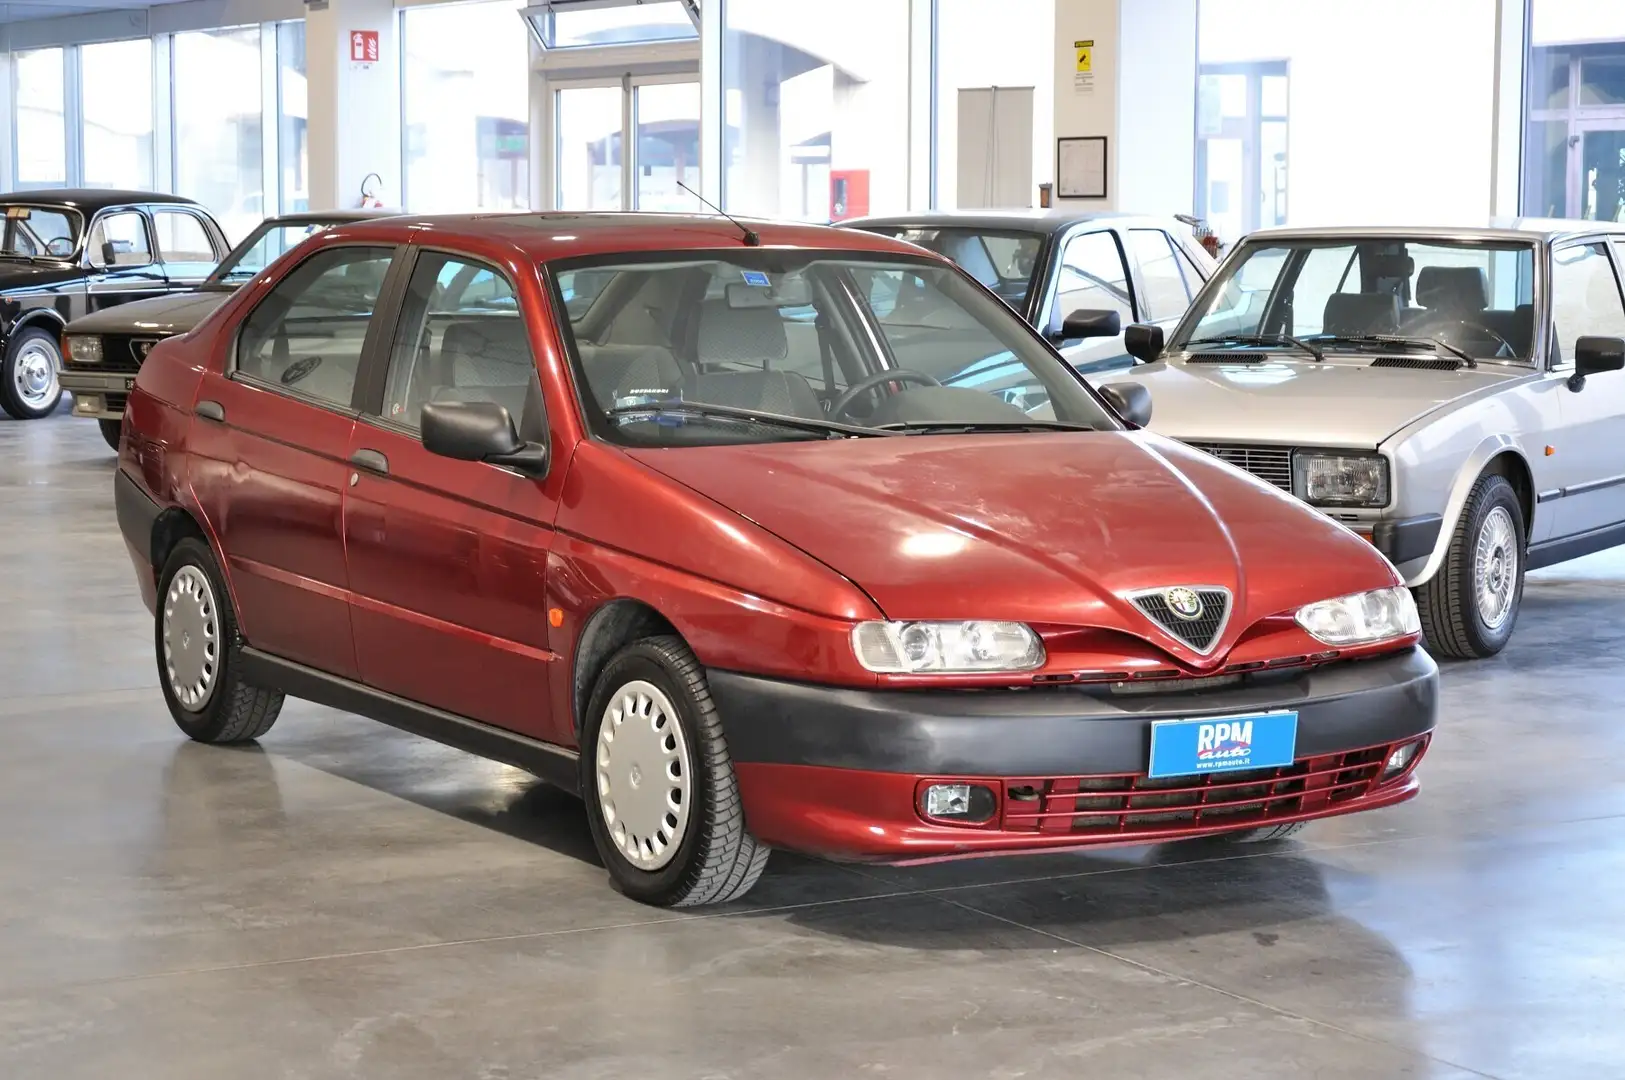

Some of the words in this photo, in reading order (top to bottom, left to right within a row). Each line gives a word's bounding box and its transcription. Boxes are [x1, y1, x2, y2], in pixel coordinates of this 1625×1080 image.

[1197, 720, 1253, 753] RPM
[1199, 746, 1252, 760] auto
[1196, 758, 1251, 769] www.rpmauto.it
